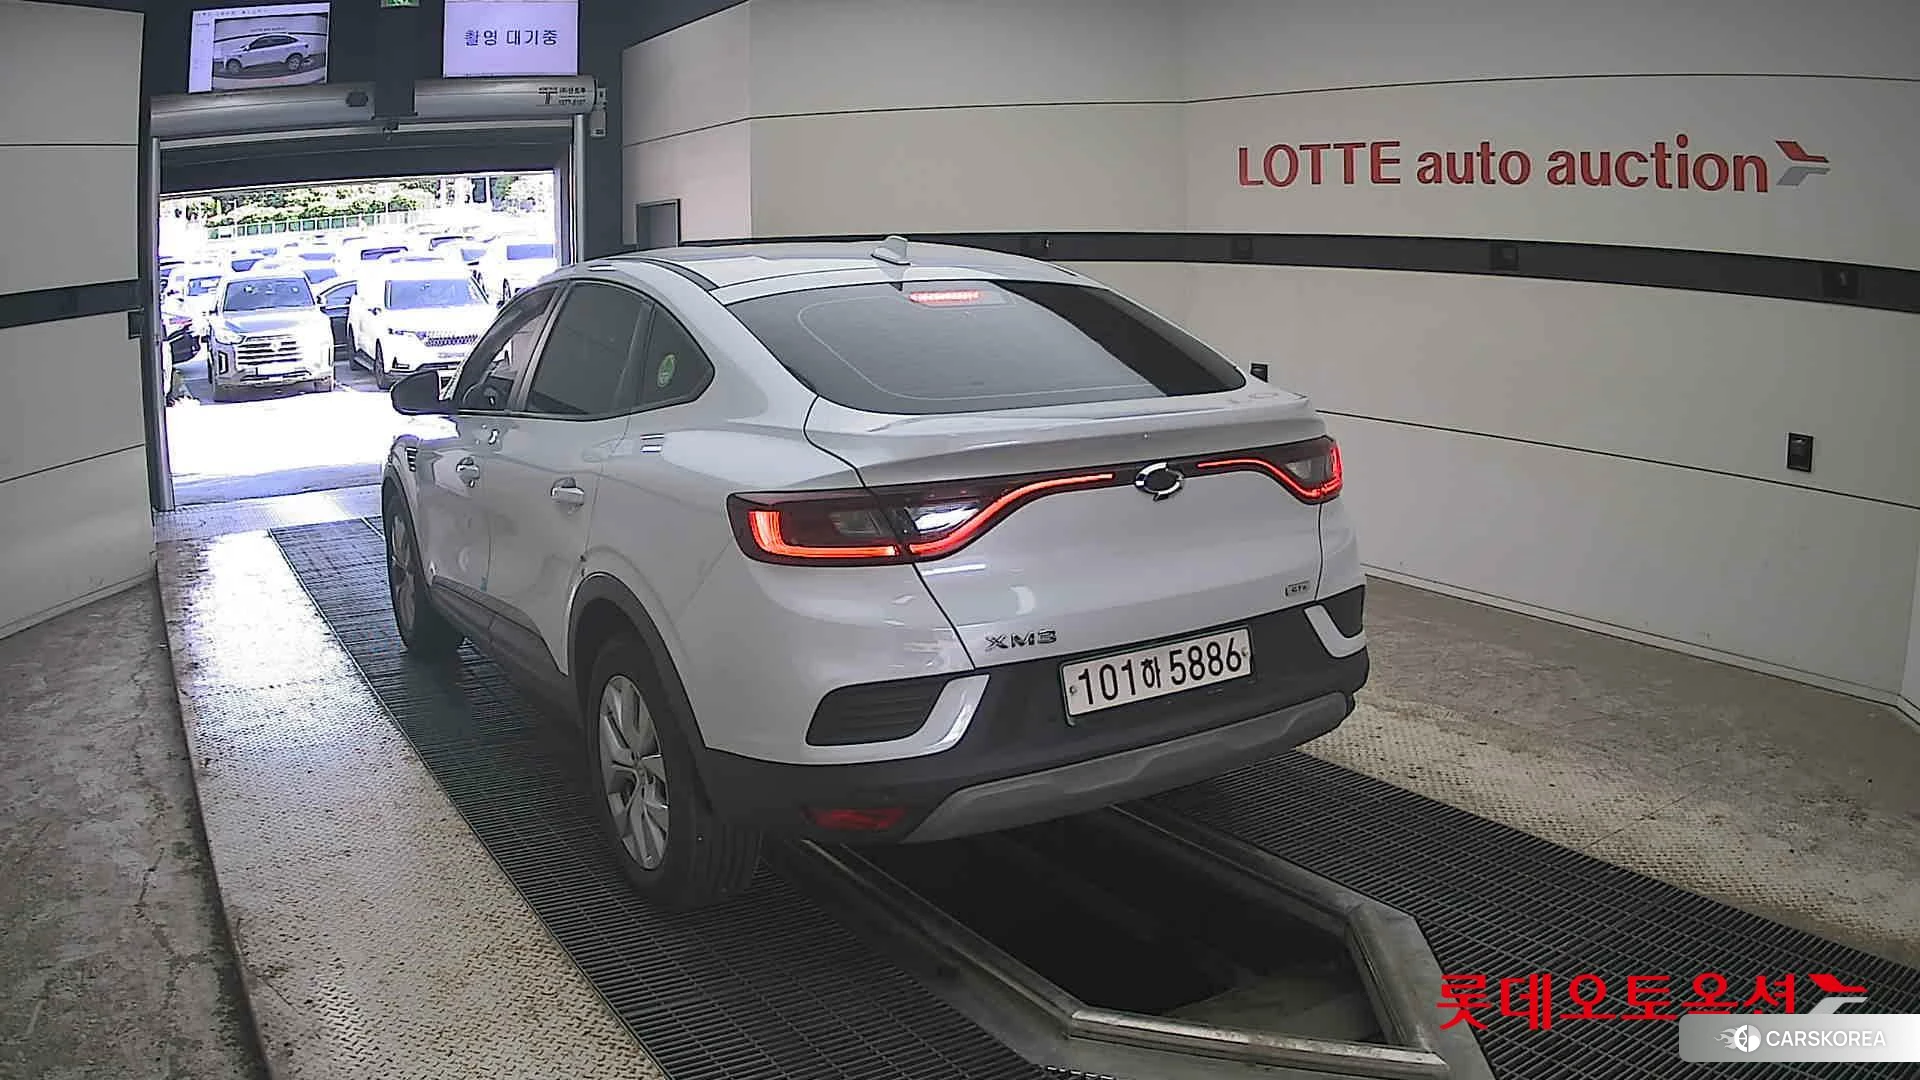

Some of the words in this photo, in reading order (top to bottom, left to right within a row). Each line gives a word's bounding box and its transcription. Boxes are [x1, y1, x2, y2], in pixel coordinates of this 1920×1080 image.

[506, 29, 558, 46] 대기중
[1239, 142, 1400, 188] LOTTE
[1416, 141, 1531, 185] auto
[1546, 134, 1769, 192] auction
[984, 630, 1057, 652] XM3
[1078, 656, 1161, 705] 101하
[1169, 637, 1242, 686] 5886
